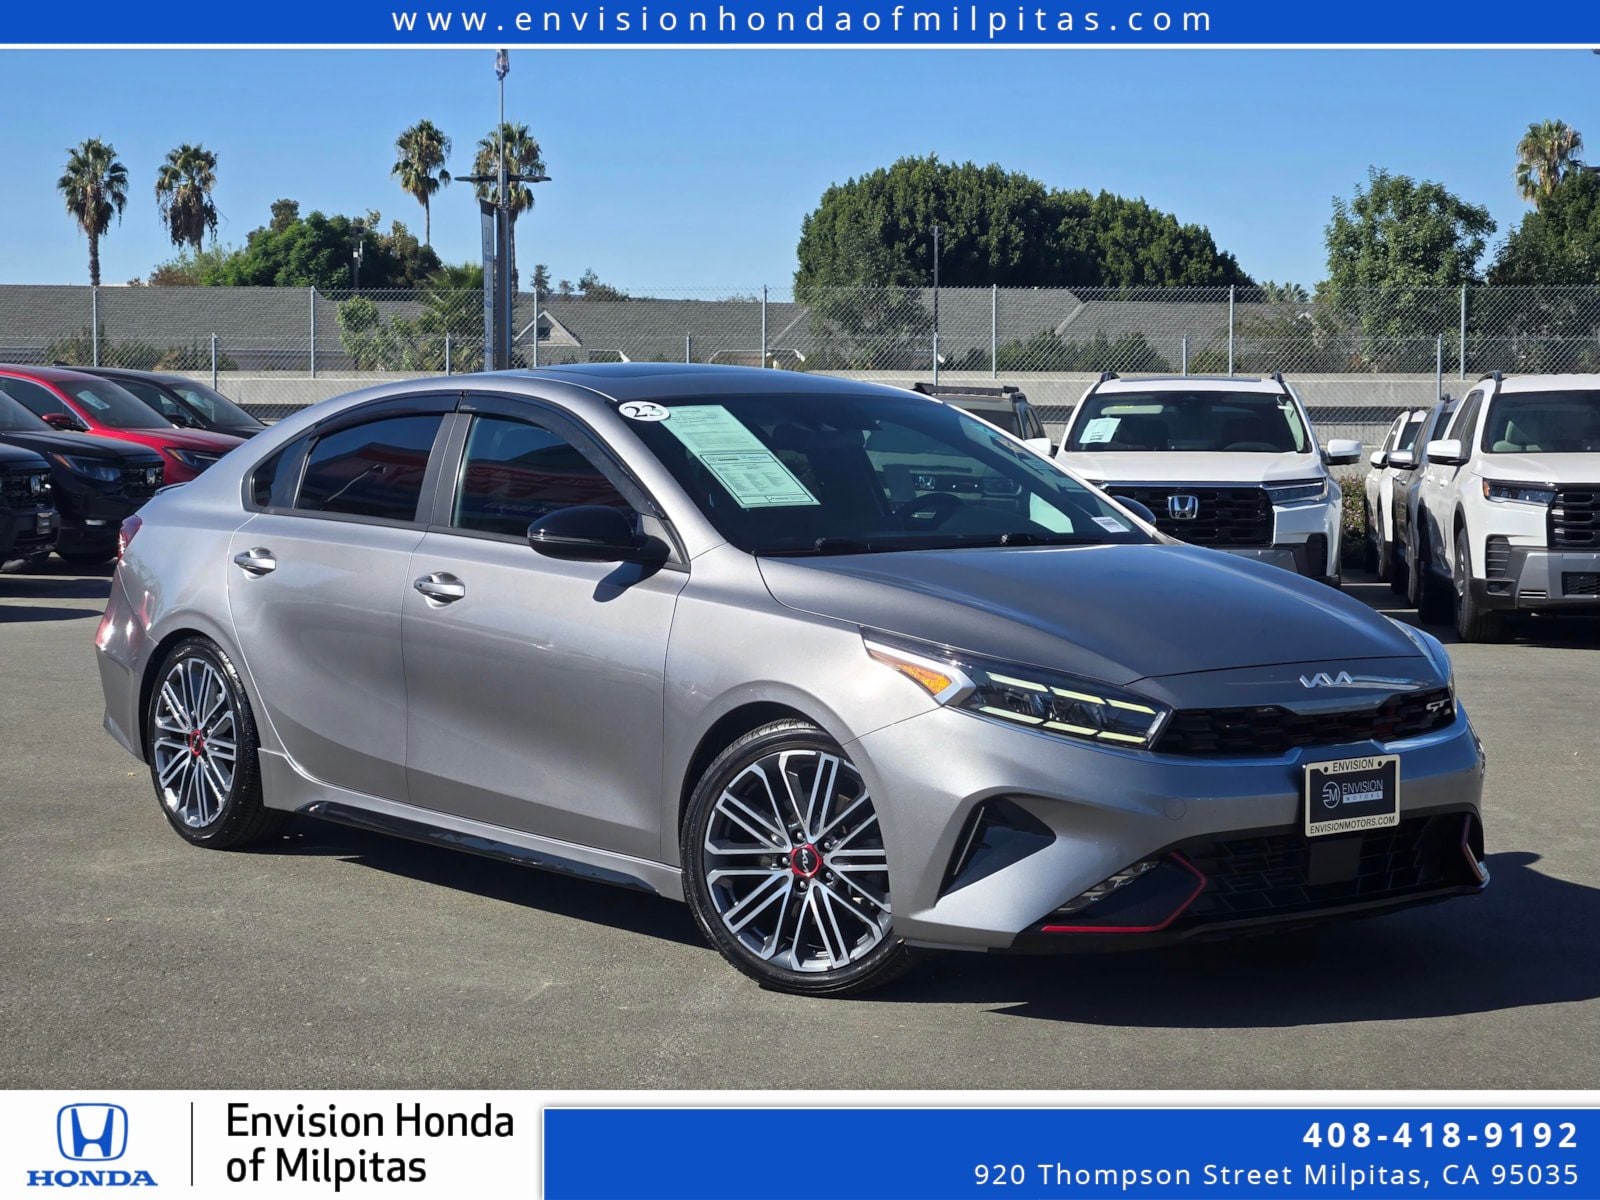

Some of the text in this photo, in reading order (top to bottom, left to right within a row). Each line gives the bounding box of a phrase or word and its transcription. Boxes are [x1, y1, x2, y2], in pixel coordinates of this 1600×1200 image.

[624, 404, 664, 418] 23
[1426, 699, 1450, 712] GT
[1333, 758, 1374, 772] ENVISION
[1342, 779, 1384, 794] ENVISION
[1310, 816, 1395, 834] ENVISIONMOTORS.COM
